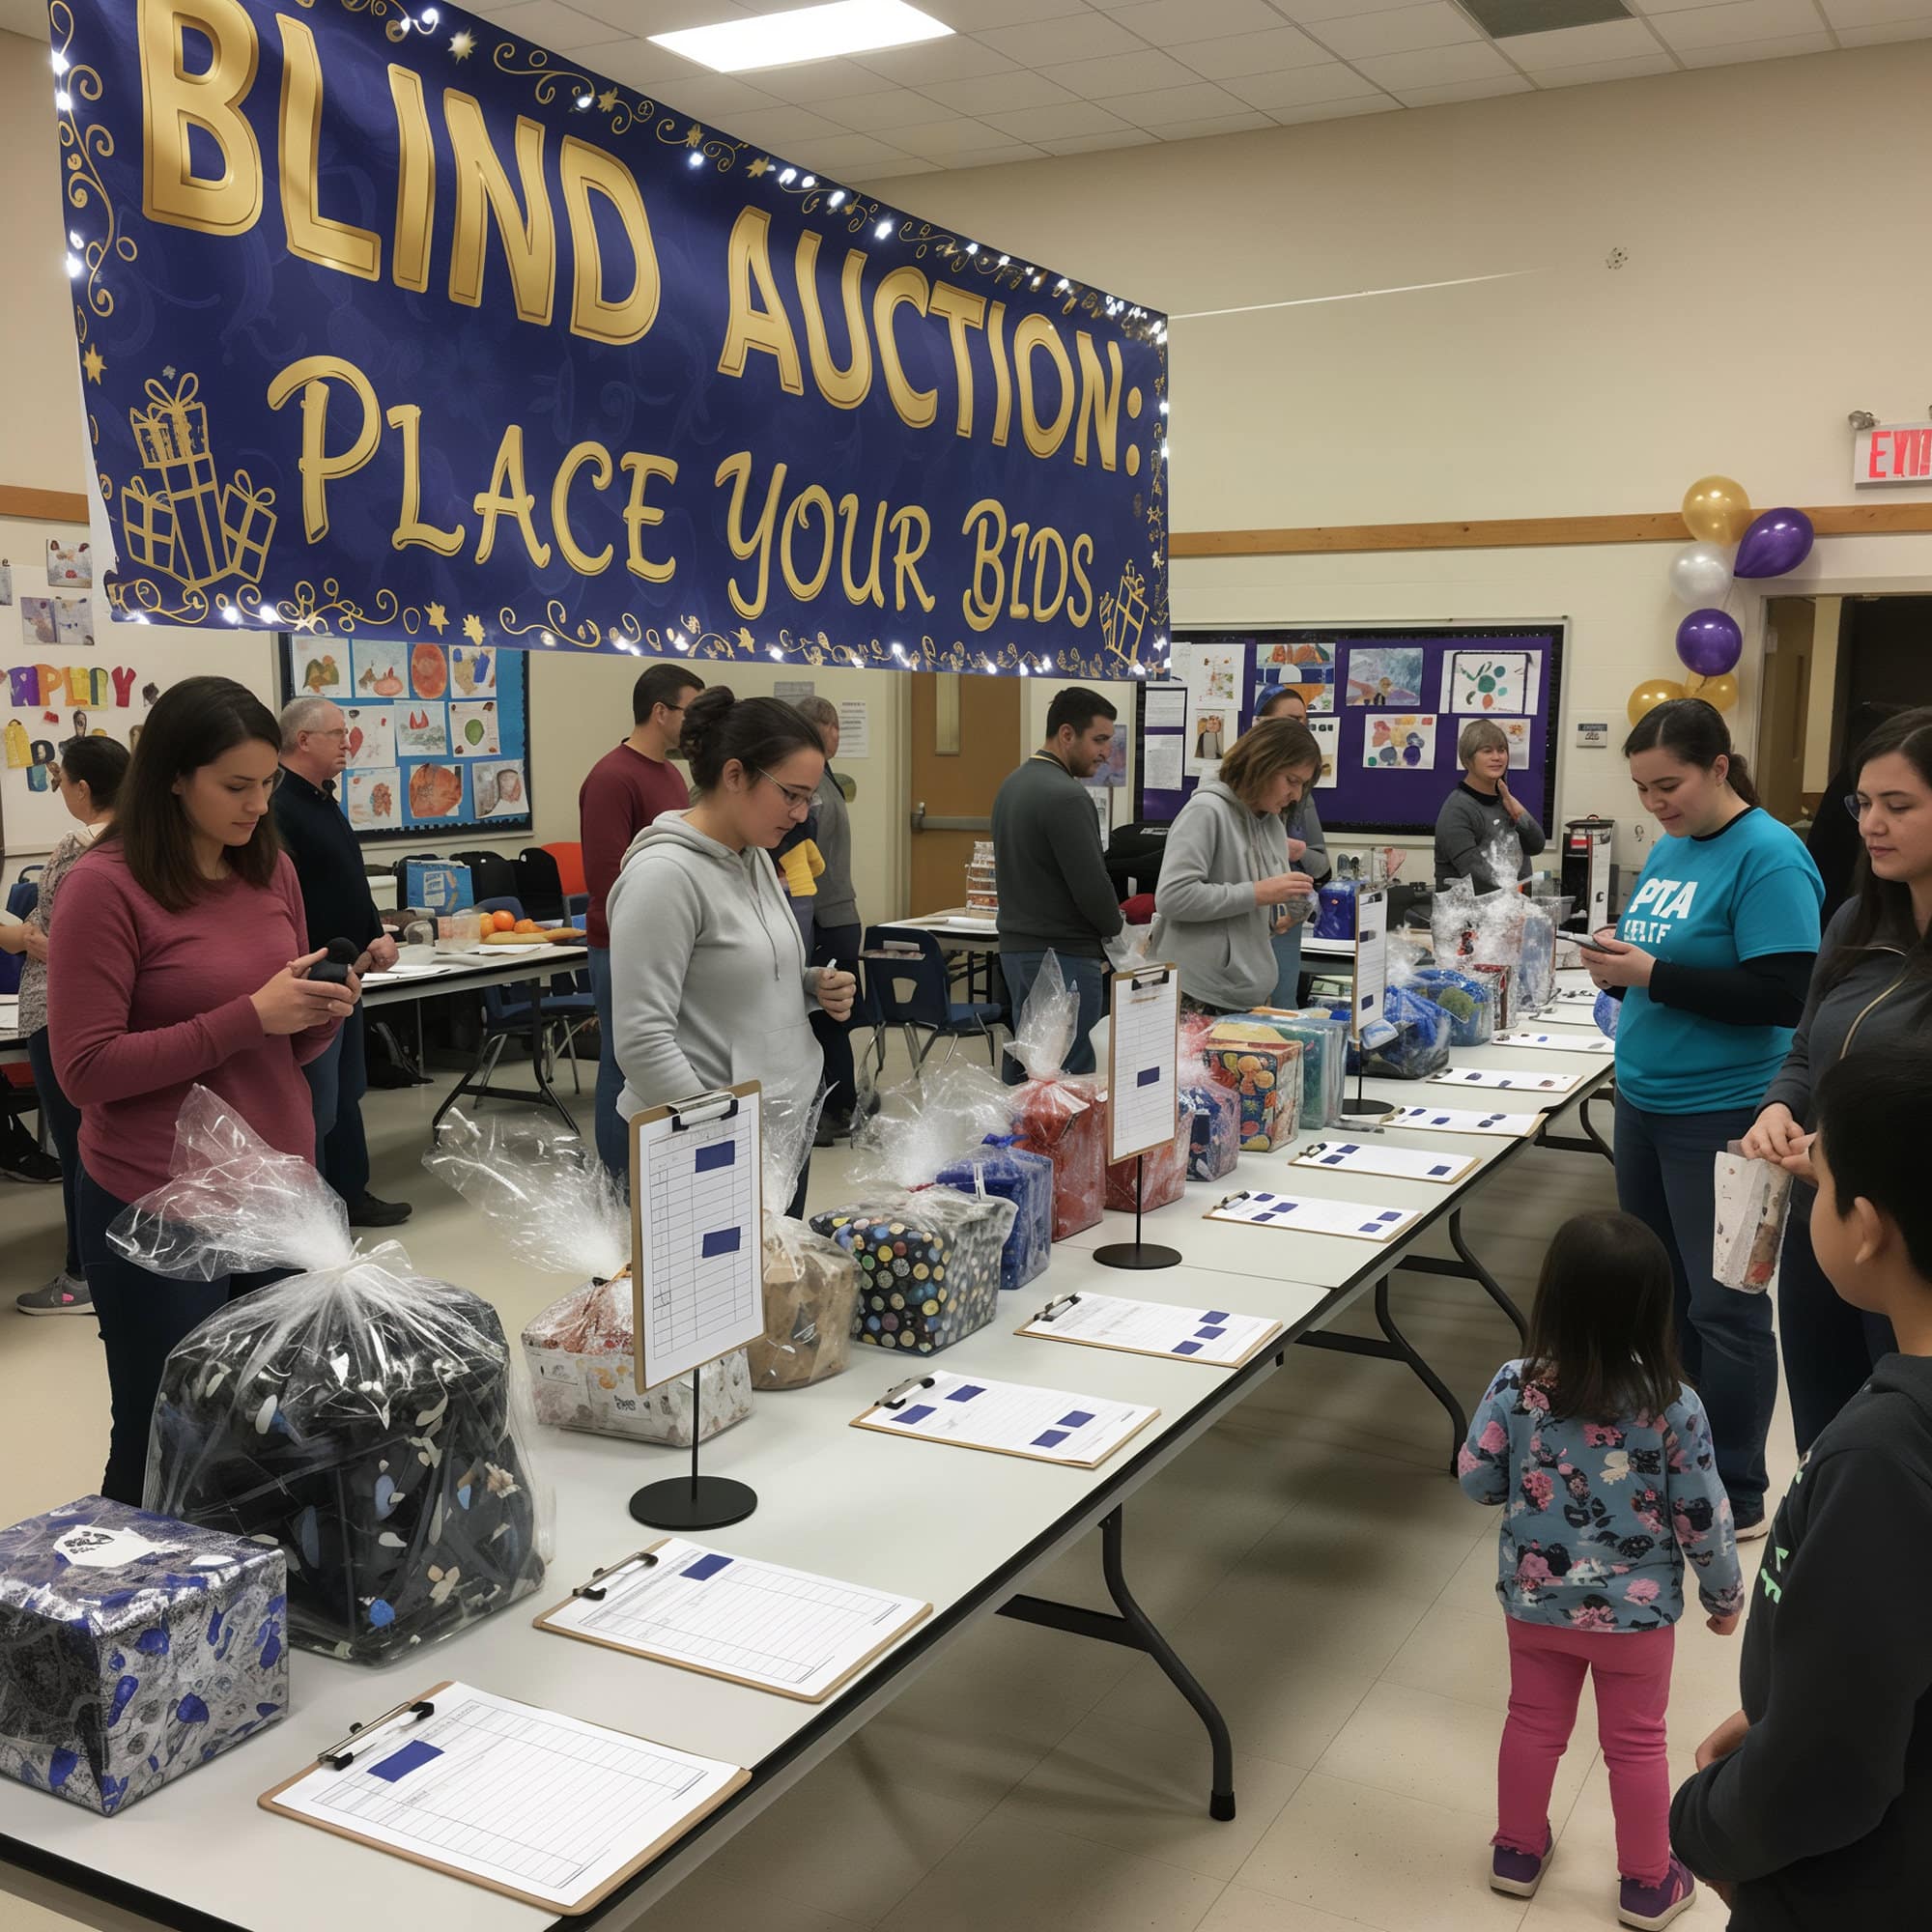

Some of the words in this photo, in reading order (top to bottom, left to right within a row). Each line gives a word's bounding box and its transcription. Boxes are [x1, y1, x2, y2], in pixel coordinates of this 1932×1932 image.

[136, 0, 661, 346] BLIND
[717, 205, 1143, 477] AUCTION:
[267, 355, 679, 583] PLACE
[714, 450, 935, 621] YOUR
[961, 497, 1094, 632] BIDS
[1628, 877, 1699, 920] PTA
